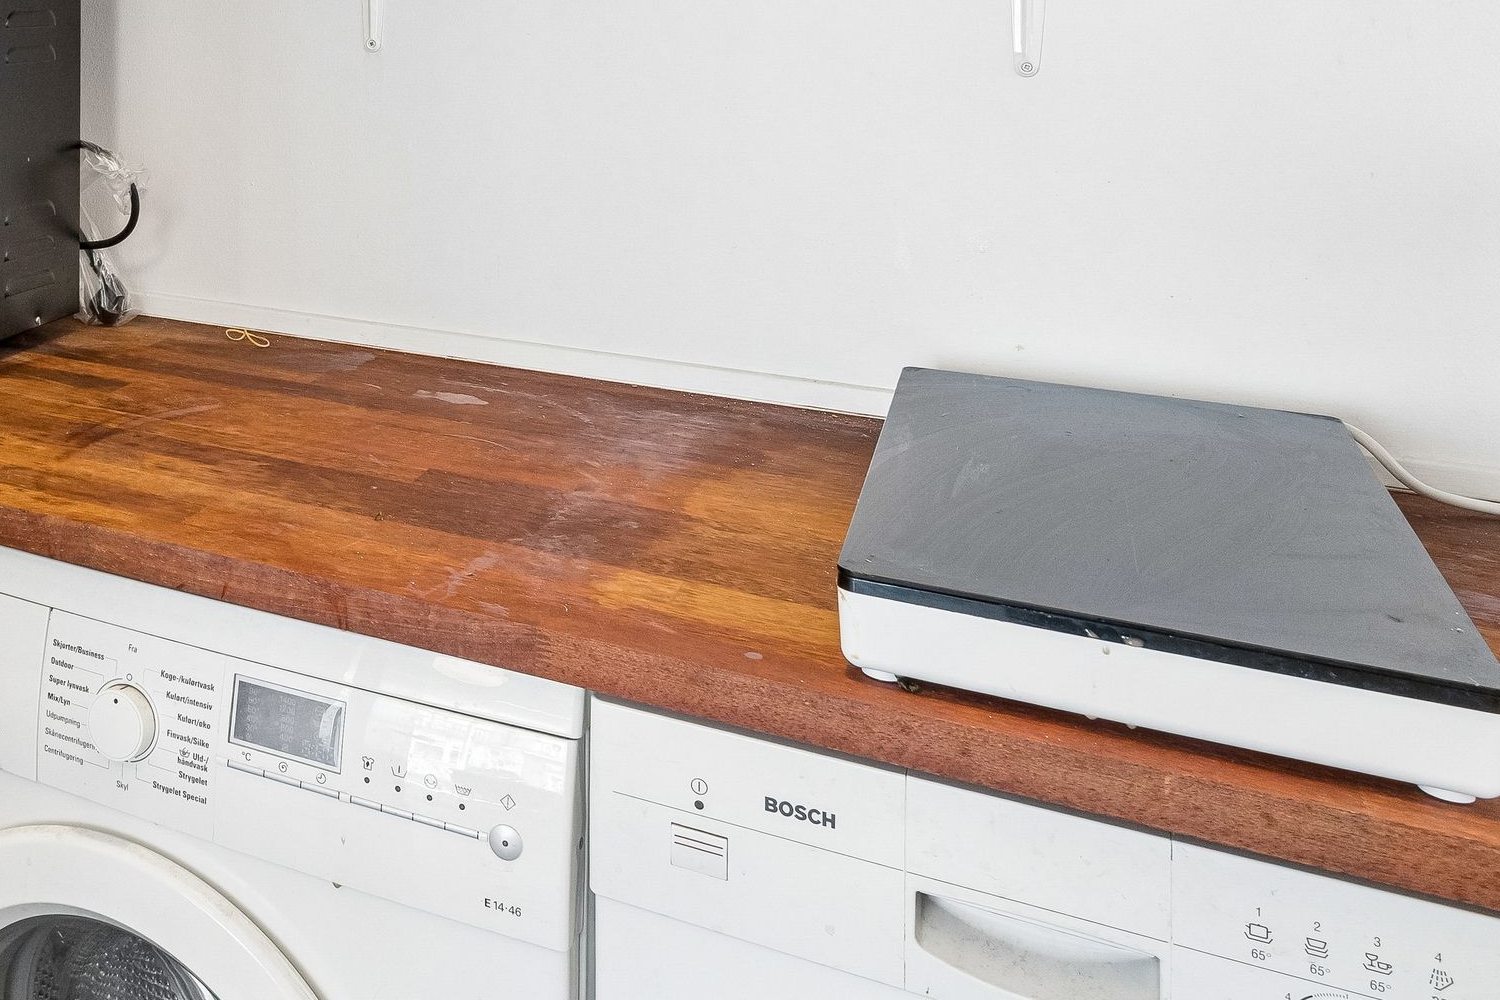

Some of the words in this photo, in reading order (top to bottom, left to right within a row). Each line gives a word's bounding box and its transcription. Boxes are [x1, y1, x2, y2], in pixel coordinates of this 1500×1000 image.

[52, 638, 105, 660] Skjorter/Business
[128, 643, 138, 653] Fra
[50, 656, 74, 670] Outdoor
[48, 674, 66, 686] Super
[47, 692, 71, 706] Mix/Lyn
[45, 709, 81, 728] Udpumpning
[166, 729, 210, 749] Finvask/Silke
[44, 744, 84, 765] Centrifugering
[177, 756, 208, 772] håndvask
[178, 770, 208, 786] Strygelet
[116, 780, 129, 791] Skyl
[152, 780, 181, 797] Strygelet
[182, 790, 207, 804] Special
[764, 796, 836, 829] BOSCH
[485, 898, 491, 908] E
[1255, 907, 1261, 917] 1
[1314, 922, 1321, 932] 2
[1373, 937, 1381, 948] 3
[1434, 953, 1442, 963] 4
